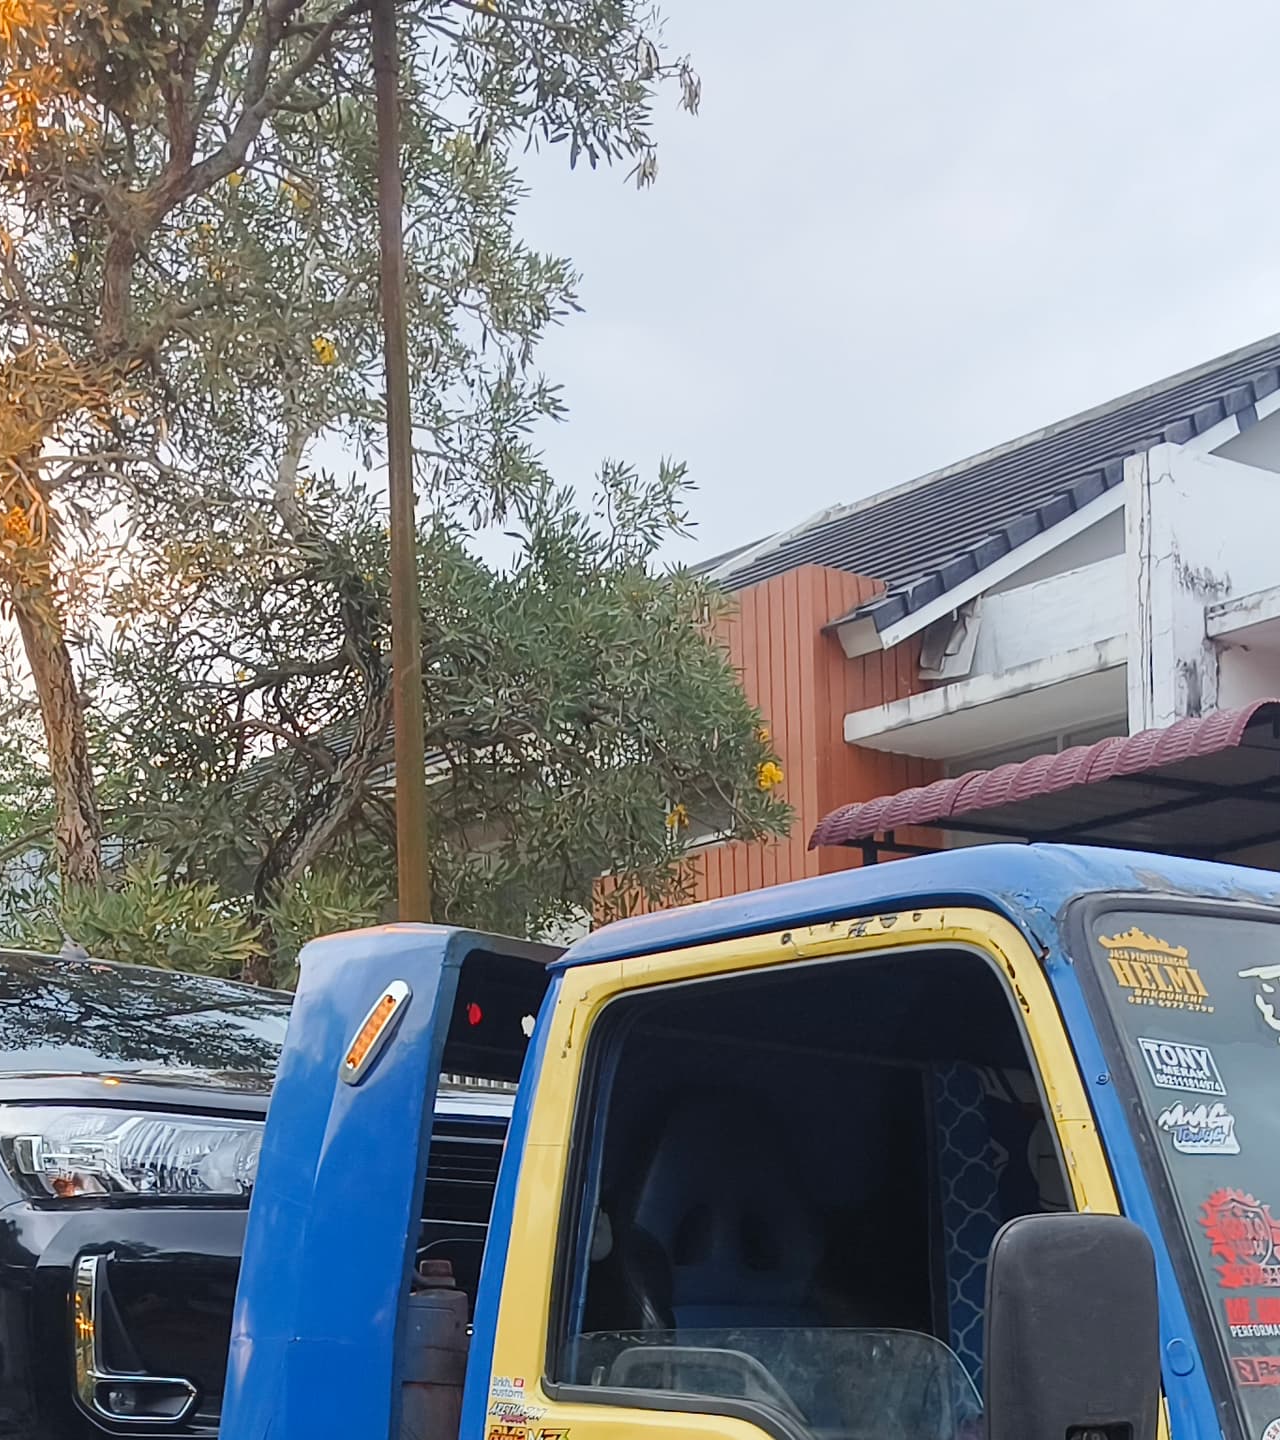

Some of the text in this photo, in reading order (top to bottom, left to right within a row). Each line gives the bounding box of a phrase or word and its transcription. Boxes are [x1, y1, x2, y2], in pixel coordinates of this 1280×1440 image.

[1107, 958, 1209, 997] HELMI
[1134, 988, 1203, 1004] BAKAUHENI
[1143, 1042, 1212, 1077] TONY
[1162, 1065, 1208, 1080] MERAK
